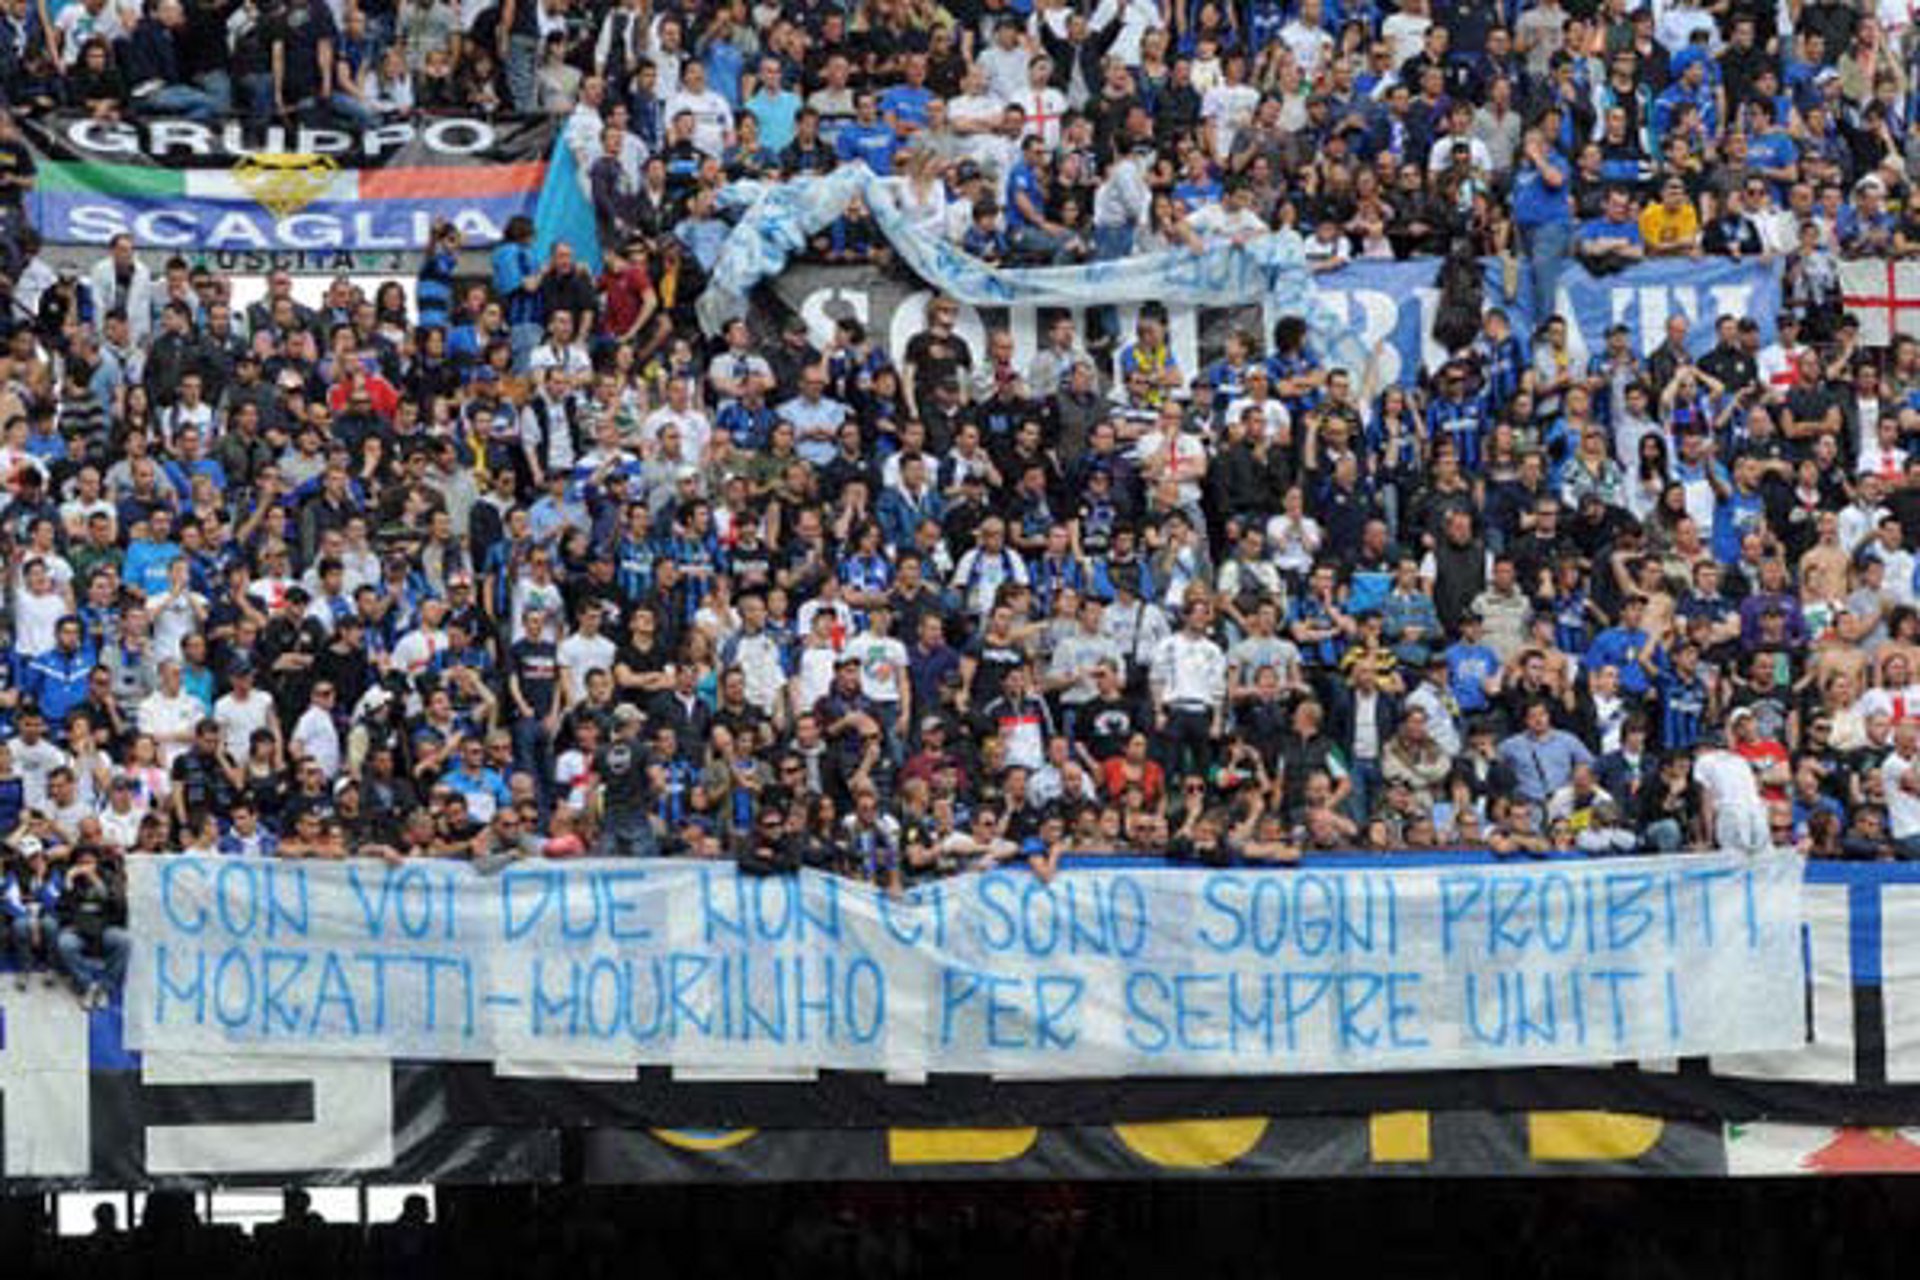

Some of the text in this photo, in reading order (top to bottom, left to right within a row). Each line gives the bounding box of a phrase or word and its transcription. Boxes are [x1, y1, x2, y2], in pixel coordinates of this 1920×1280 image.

[66, 118, 496, 157] GRUPPO
[69, 205, 503, 248] SCAGLIA
[161, 857, 1760, 959] CON VOI DUE NON CI SONO SOGNI PROIBITI
[940, 968, 1086, 1050] PER
[1125, 970, 1429, 1053] SEMPRE
[1466, 970, 1680, 1047] UNITI
